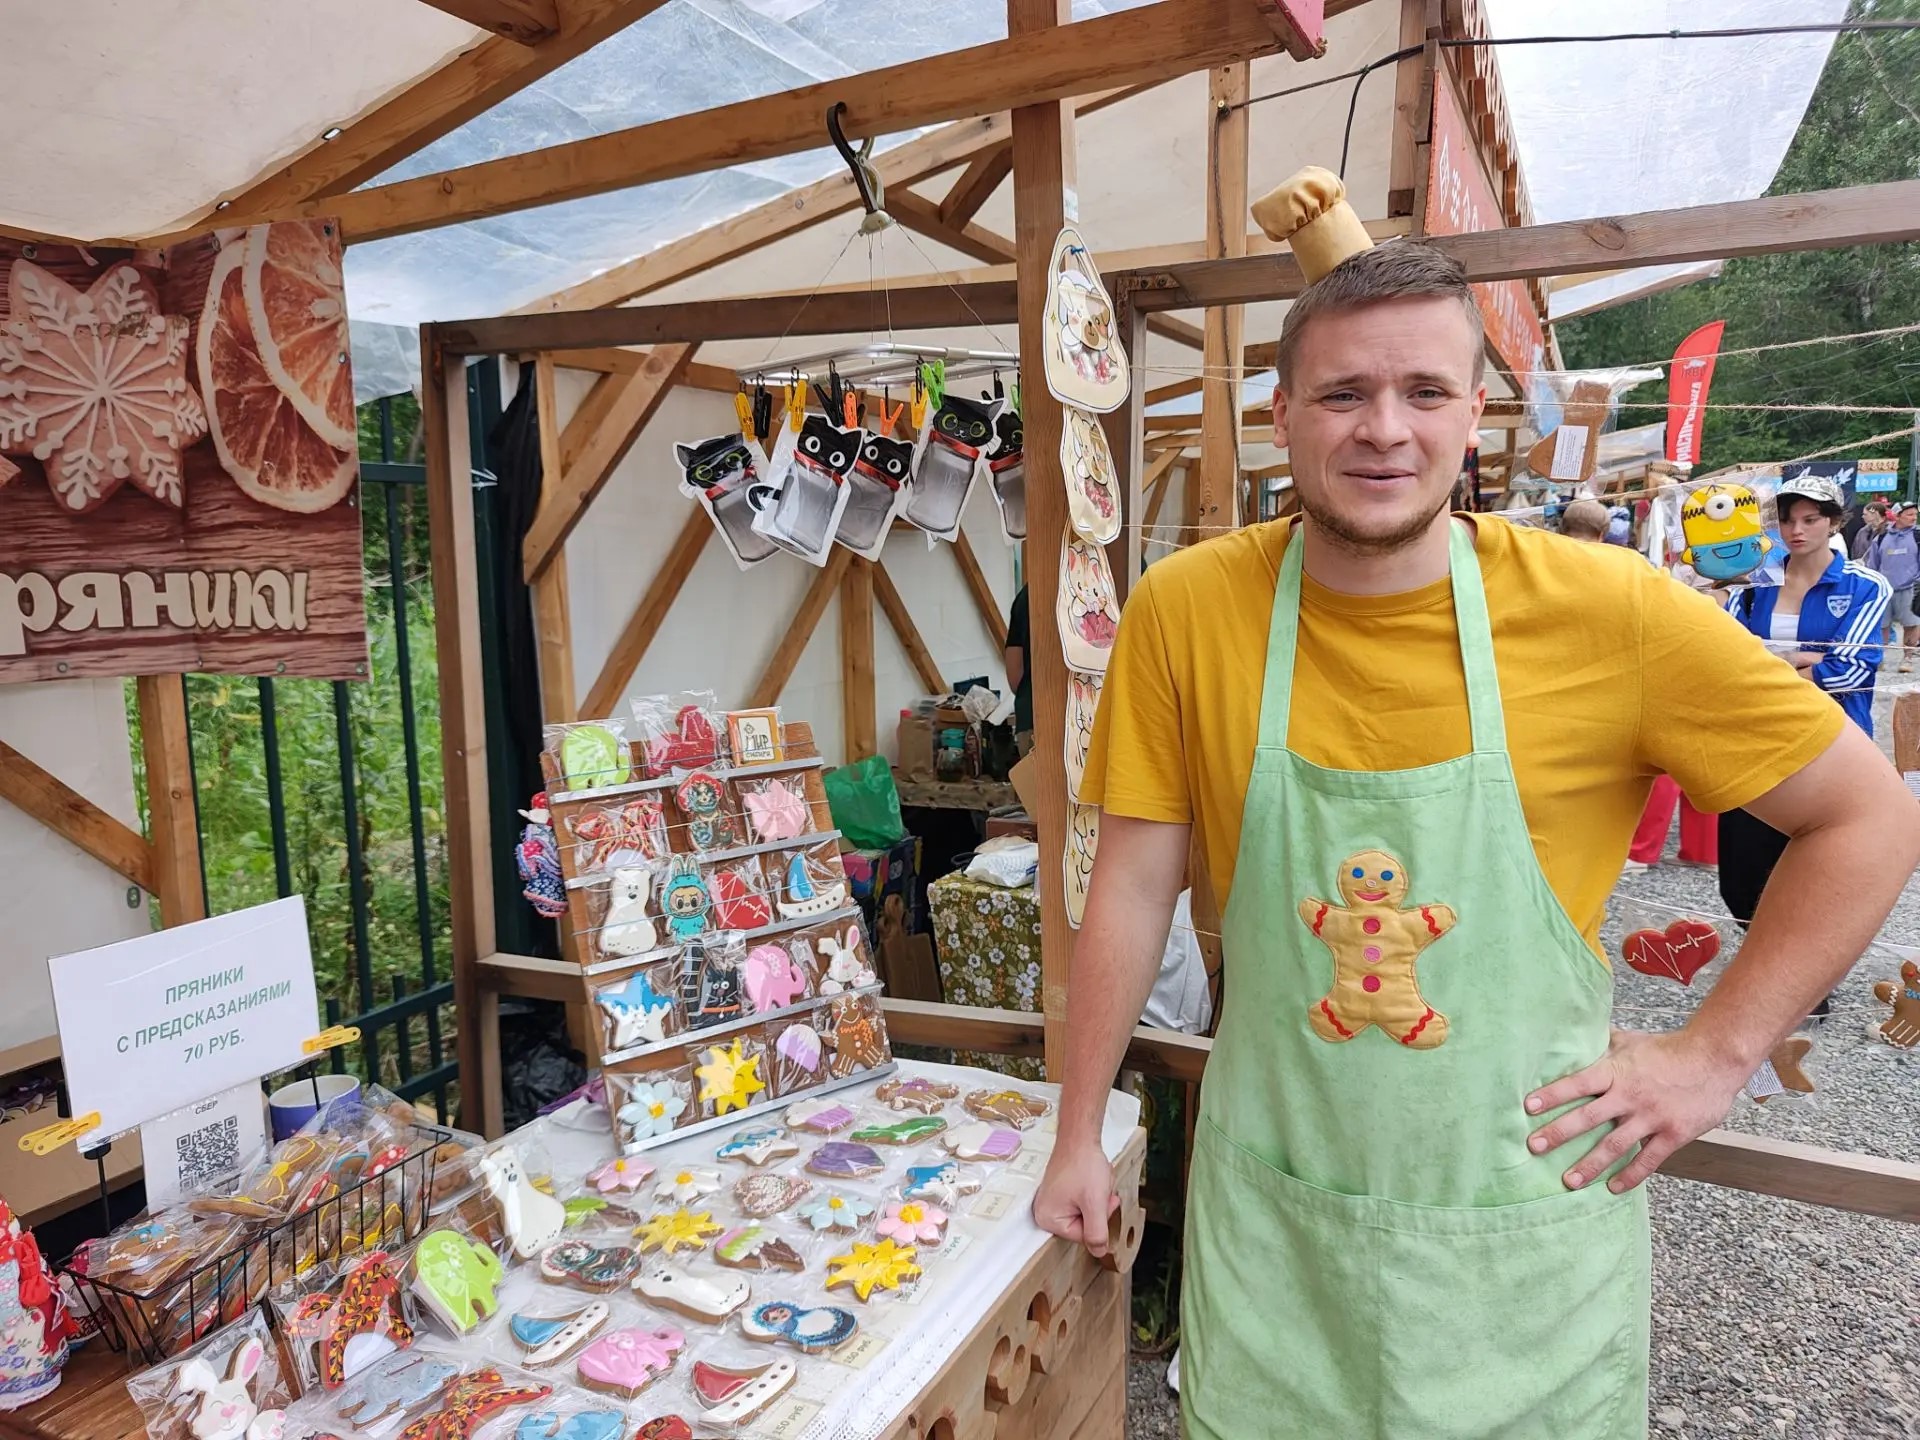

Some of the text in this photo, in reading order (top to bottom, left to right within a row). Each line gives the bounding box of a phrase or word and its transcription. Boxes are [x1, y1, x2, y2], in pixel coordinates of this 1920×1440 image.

[165, 965, 244, 1005] ПРЯНИКИ
[117, 979, 292, 1053] С ПРЕДСКАЗАНИЯМИ
[184, 1028, 245, 1063] 70 РУБ.
[195, 1100, 218, 1115] СБЕР
